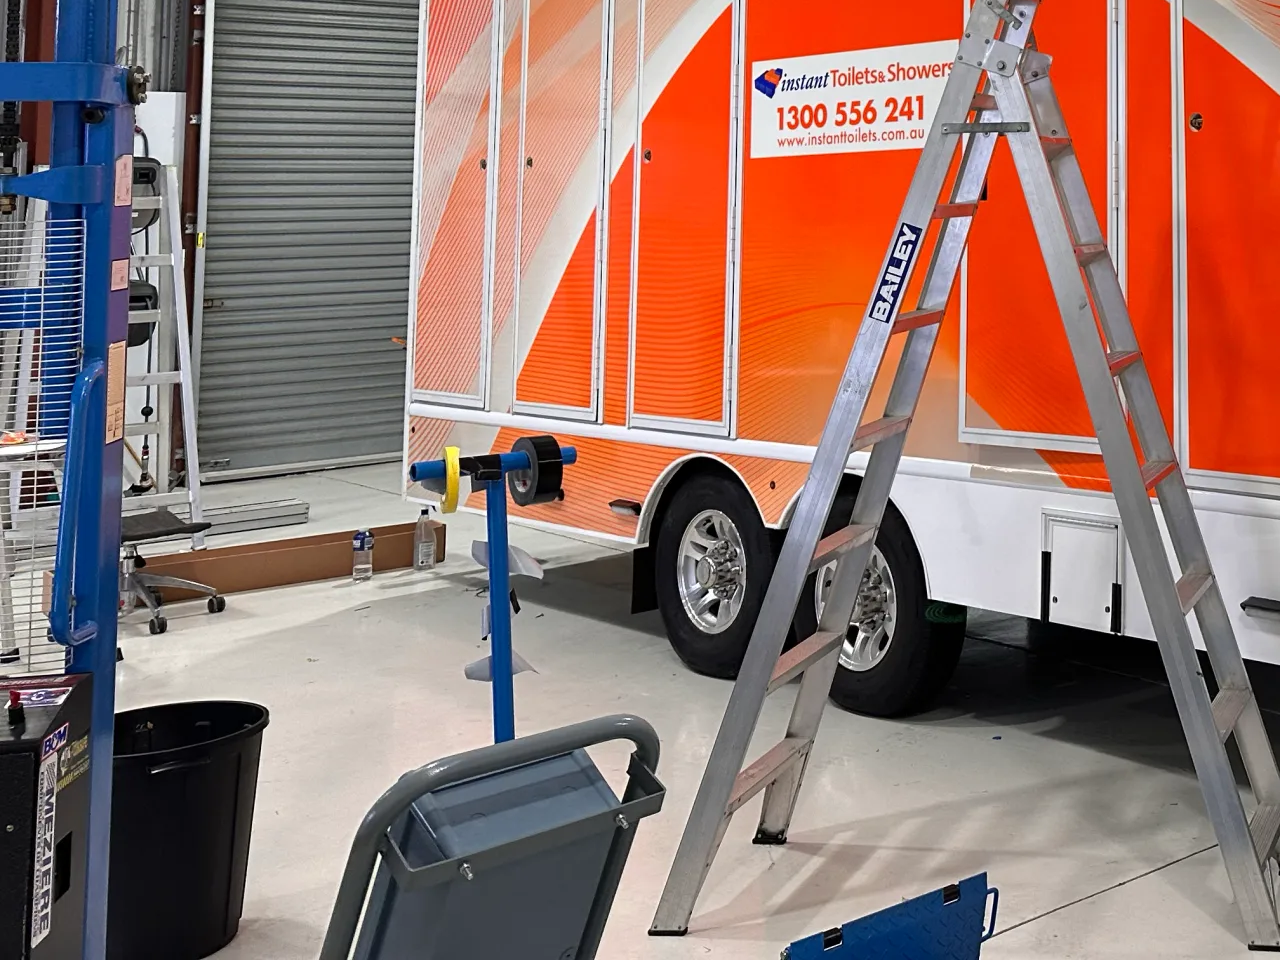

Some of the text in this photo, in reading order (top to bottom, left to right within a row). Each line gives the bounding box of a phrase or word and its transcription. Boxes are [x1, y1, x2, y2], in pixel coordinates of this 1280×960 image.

[781, 72, 830, 92] instant
[777, 95, 924, 130] 1300 556 241
[777, 127, 925, 147] www.instanttoilets.com.au
[871, 224, 917, 322] BAILEY
[40, 787, 55, 935] MEZIERE
